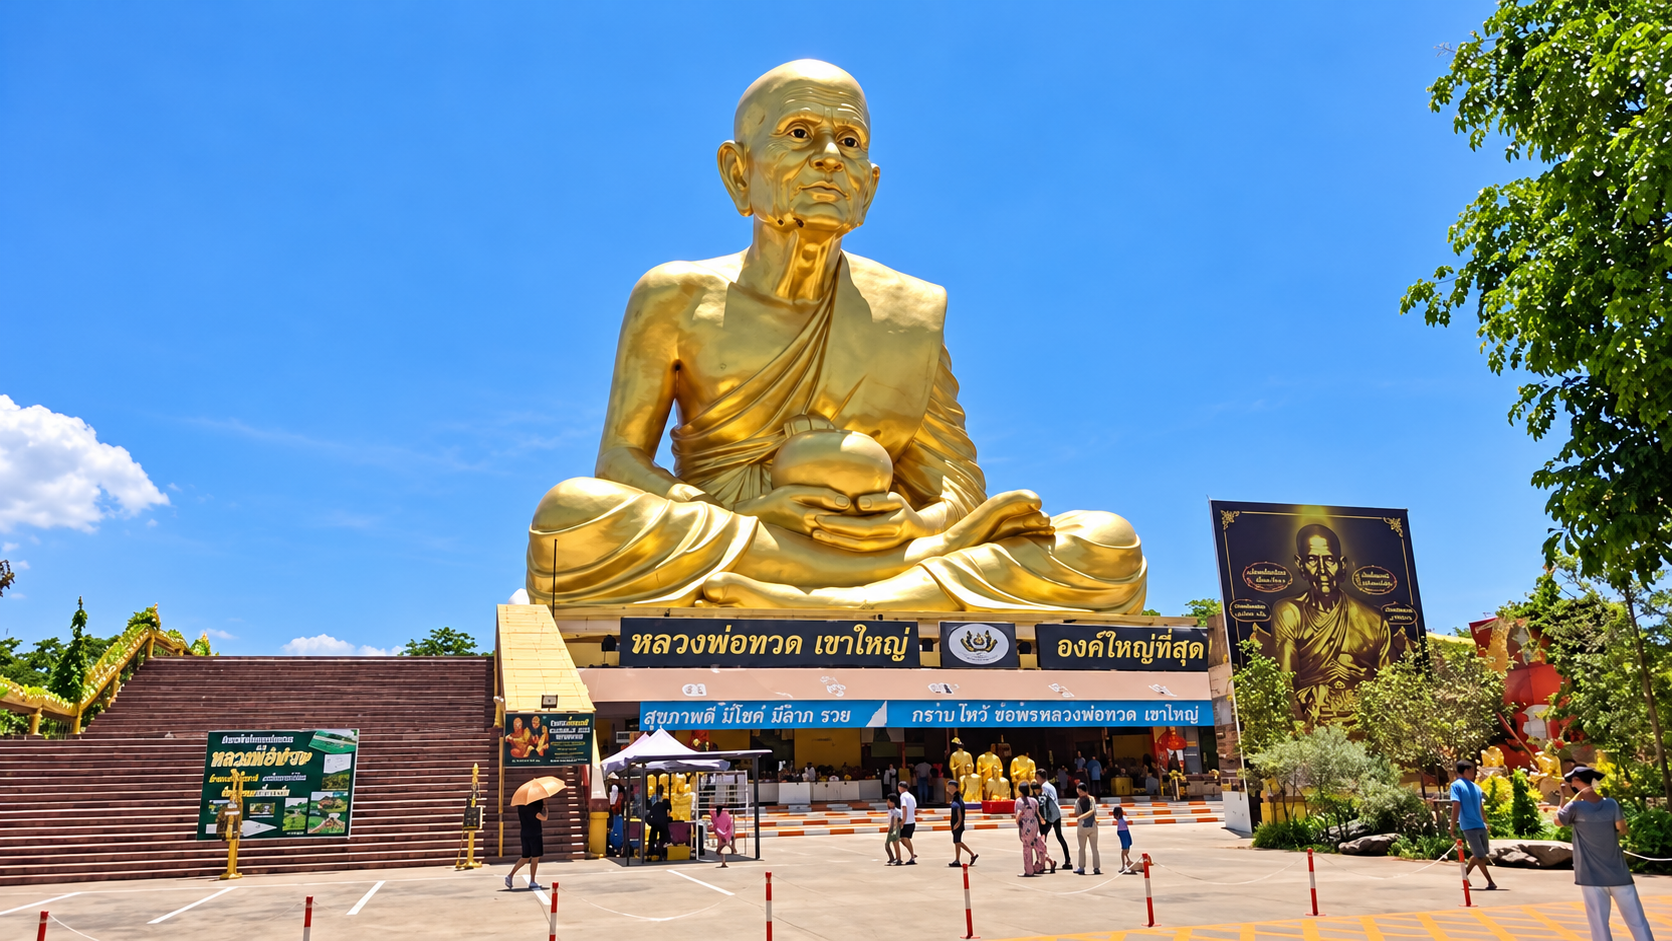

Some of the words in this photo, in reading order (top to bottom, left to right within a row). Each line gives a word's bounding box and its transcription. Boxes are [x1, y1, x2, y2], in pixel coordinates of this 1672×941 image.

[631, 625, 803, 655] หลวงพ่อทวด
[815, 624, 911, 662] เขาใหญ่
[1057, 628, 1205, 667] องค์ใหญ่ที่สุด
[644, 705, 717, 731] สุขภาพดี
[821, 710, 851, 724] รวย
[958, 703, 991, 723] ไหว้
